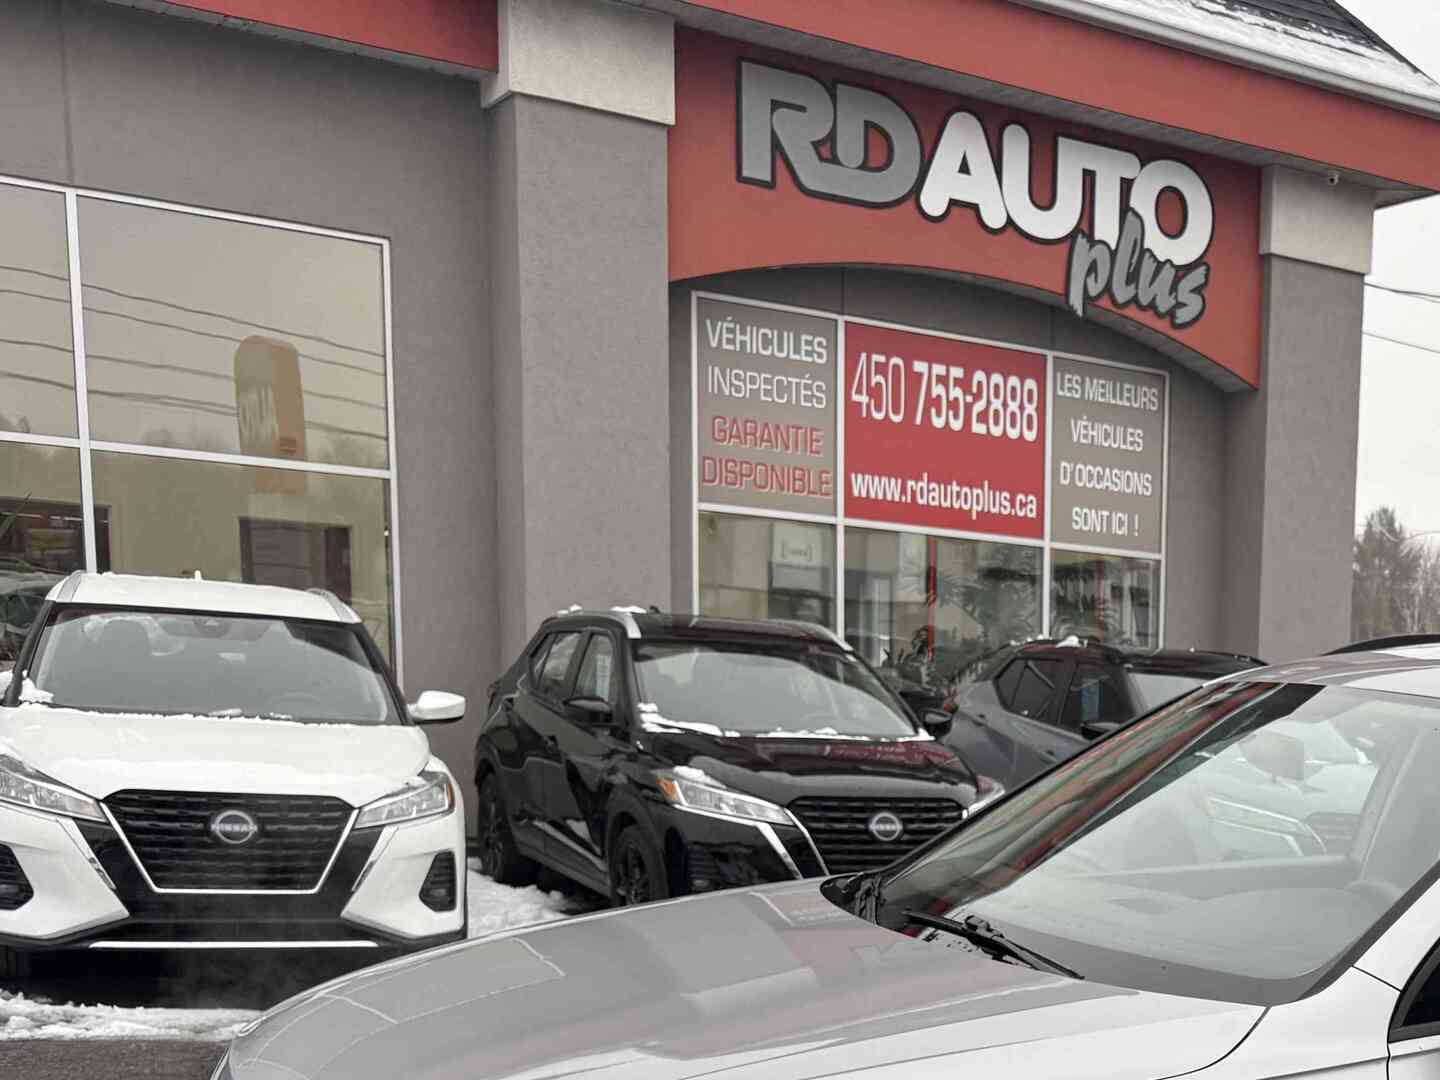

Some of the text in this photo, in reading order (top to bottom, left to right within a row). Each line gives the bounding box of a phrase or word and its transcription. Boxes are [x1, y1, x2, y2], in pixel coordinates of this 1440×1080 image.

[1069, 206, 1209, 330] plus
[706, 316, 827, 364] VÉHICULES
[708, 365, 826, 408] INSPECTÉS
[851, 352, 1038, 442] 450 755-2888
[1057, 371, 1159, 411] LES MEILLEURS
[712, 415, 824, 456] GARANTIE
[1071, 416, 1143, 451] VÉHICULES
[702, 455, 832, 498] DISPONIBLE
[851, 472, 1037, 520] www.rdautoplus.ca
[1072, 507, 1109, 533] SONT
[1111, 511, 1128, 536] ICI
